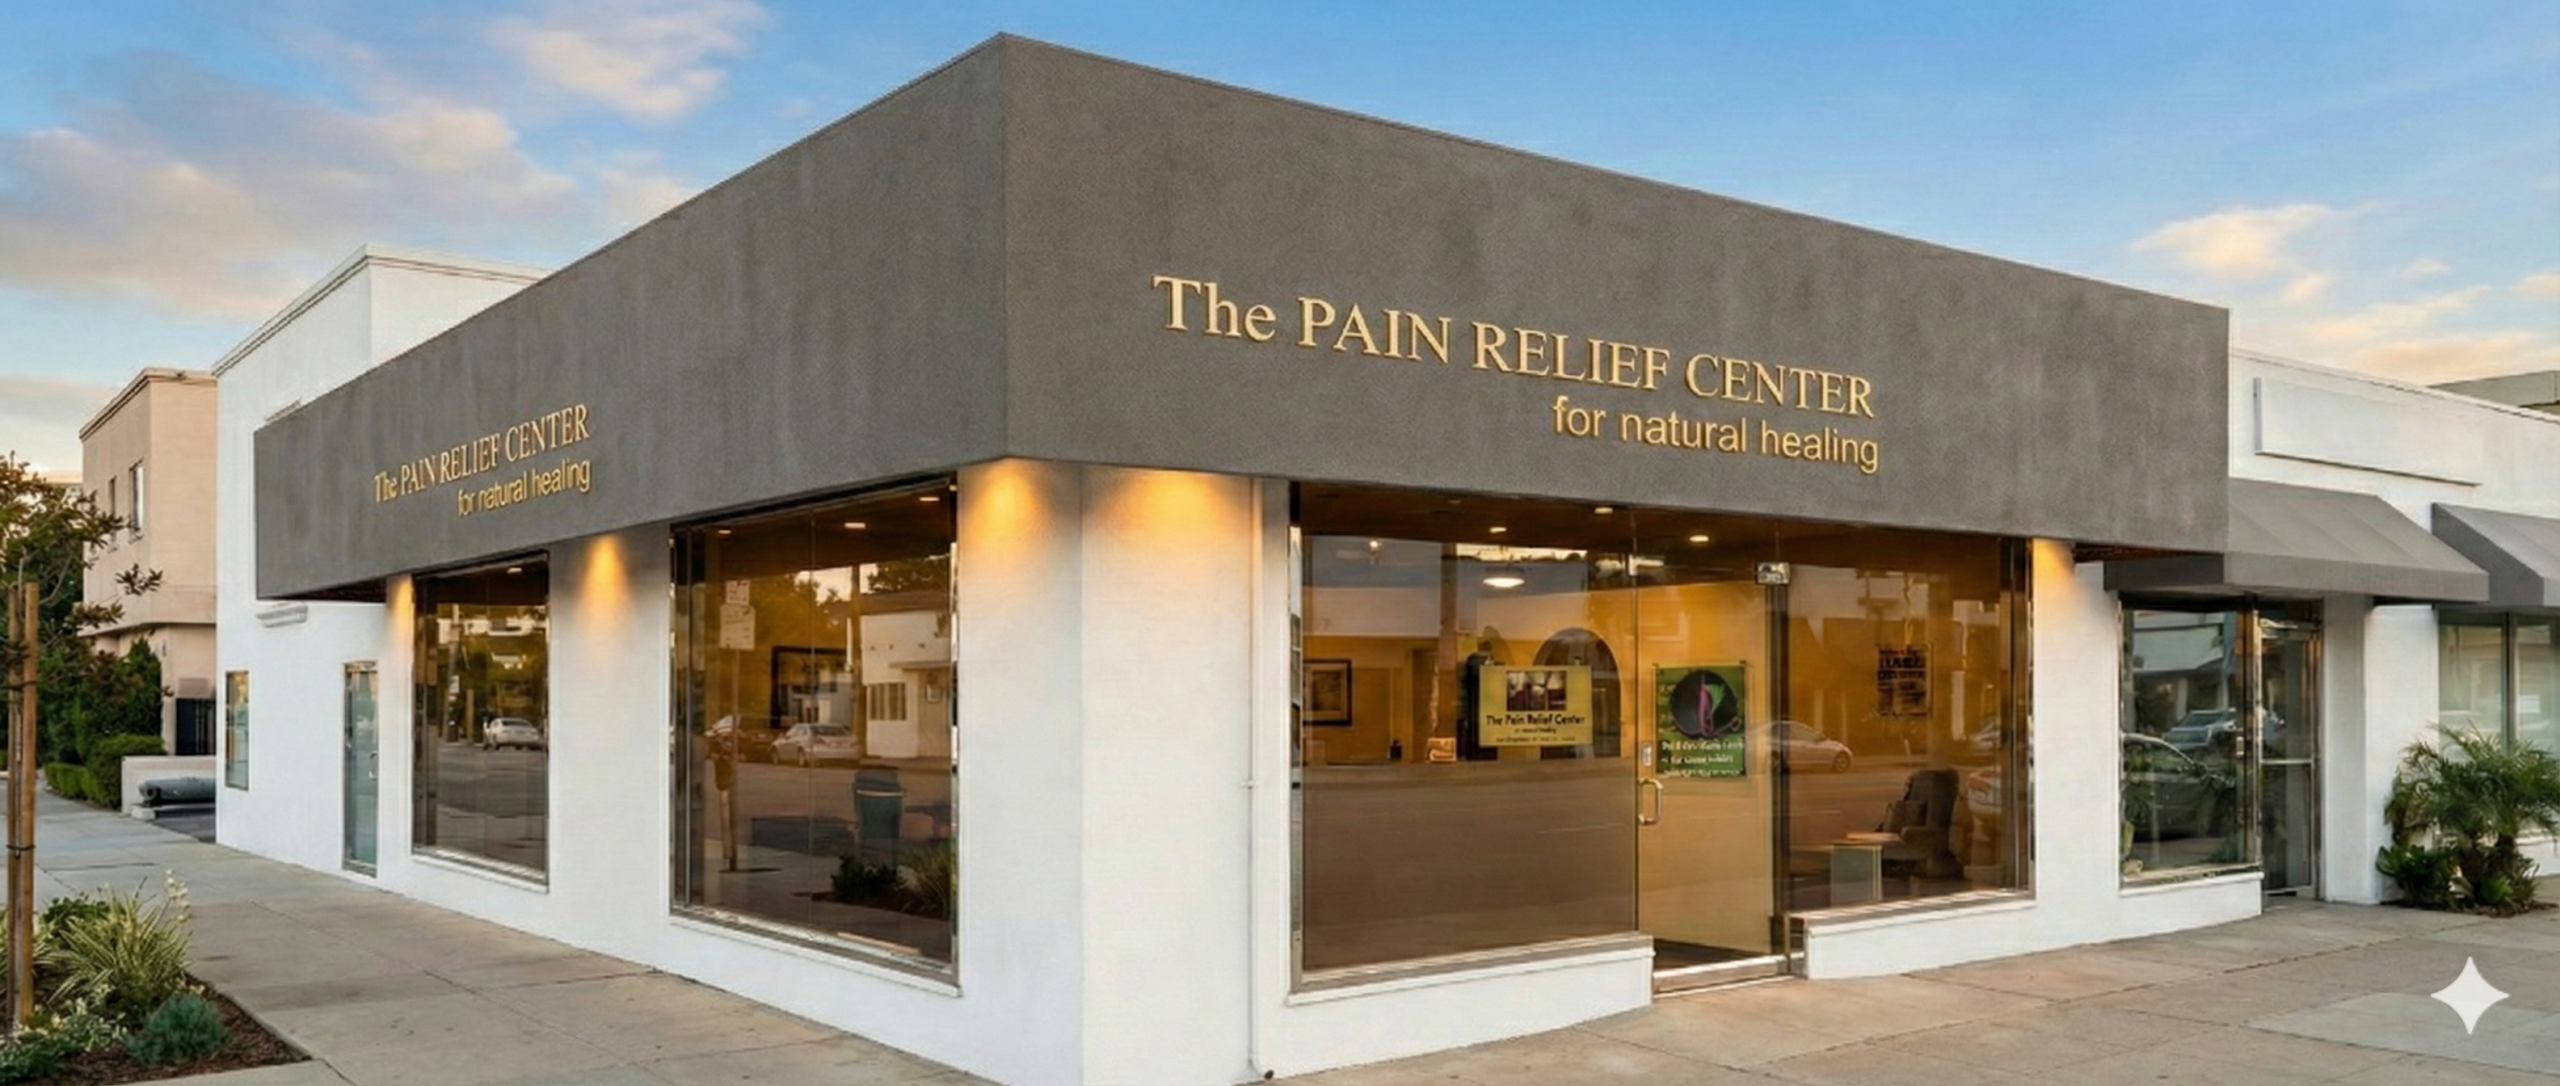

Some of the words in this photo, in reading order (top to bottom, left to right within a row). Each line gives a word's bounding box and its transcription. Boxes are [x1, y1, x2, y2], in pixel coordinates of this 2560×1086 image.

[1153, 274, 1277, 343] The
[1297, 296, 1452, 365] PAIN
[1471, 321, 1671, 391] RELIEF
[1685, 352, 1875, 419] CENTER
[374, 470, 398, 503] The
[401, 454, 438, 496] PAIN
[440, 432, 502, 484] RELIEF
[505, 403, 591, 463] CENTER
[1552, 394, 1607, 437] for
[1620, 409, 1748, 454] natural
[1760, 418, 1879, 475] healing
[457, 488, 477, 517] for
[478, 469, 528, 511] natural
[532, 457, 592, 494] healing
[1486, 714, 1503, 726] The
[1505, 713, 1525, 726] Pain
[1527, 713, 1552, 726] Relief
[1554, 713, 1586, 726] Center
